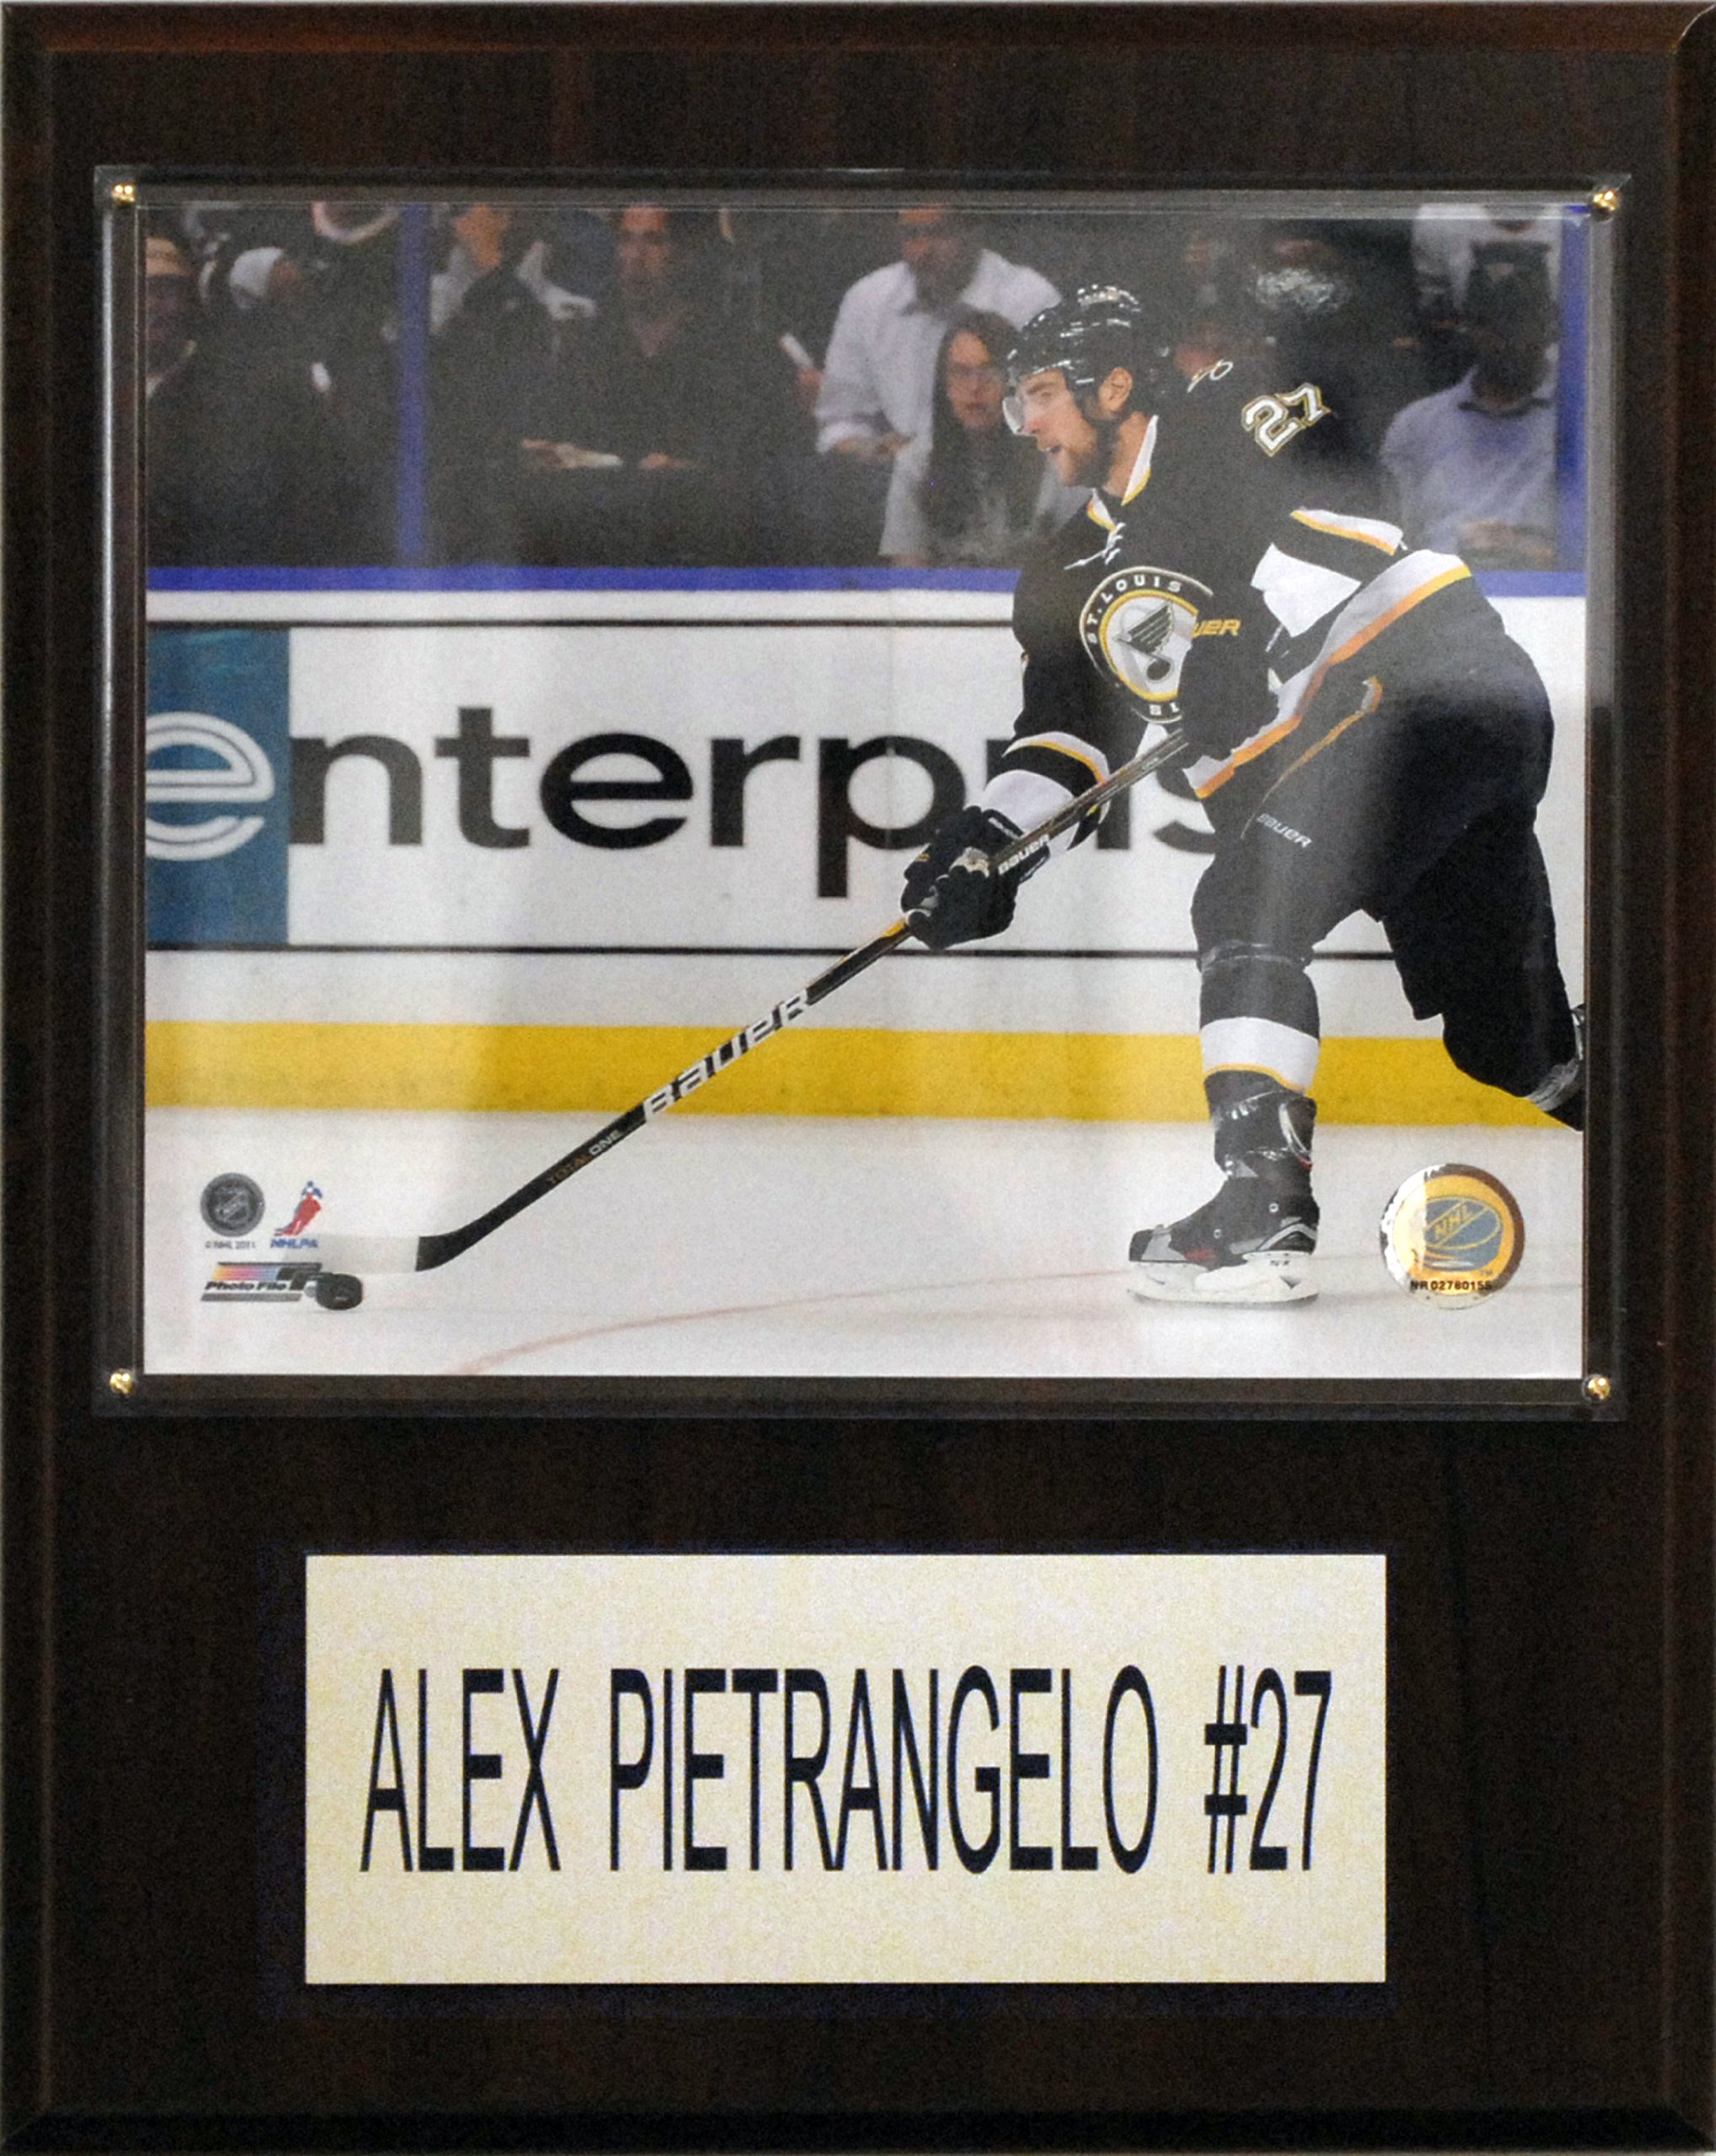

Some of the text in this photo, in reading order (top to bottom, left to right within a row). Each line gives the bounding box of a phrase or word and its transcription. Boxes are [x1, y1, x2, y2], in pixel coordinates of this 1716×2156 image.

[1242, 383, 1331, 456] 27
[1191, 619, 1241, 638] UER
[642, 990, 807, 1121] BAUER
[360, 1665, 1332, 1874] ALEX PIETRANGELO #27
